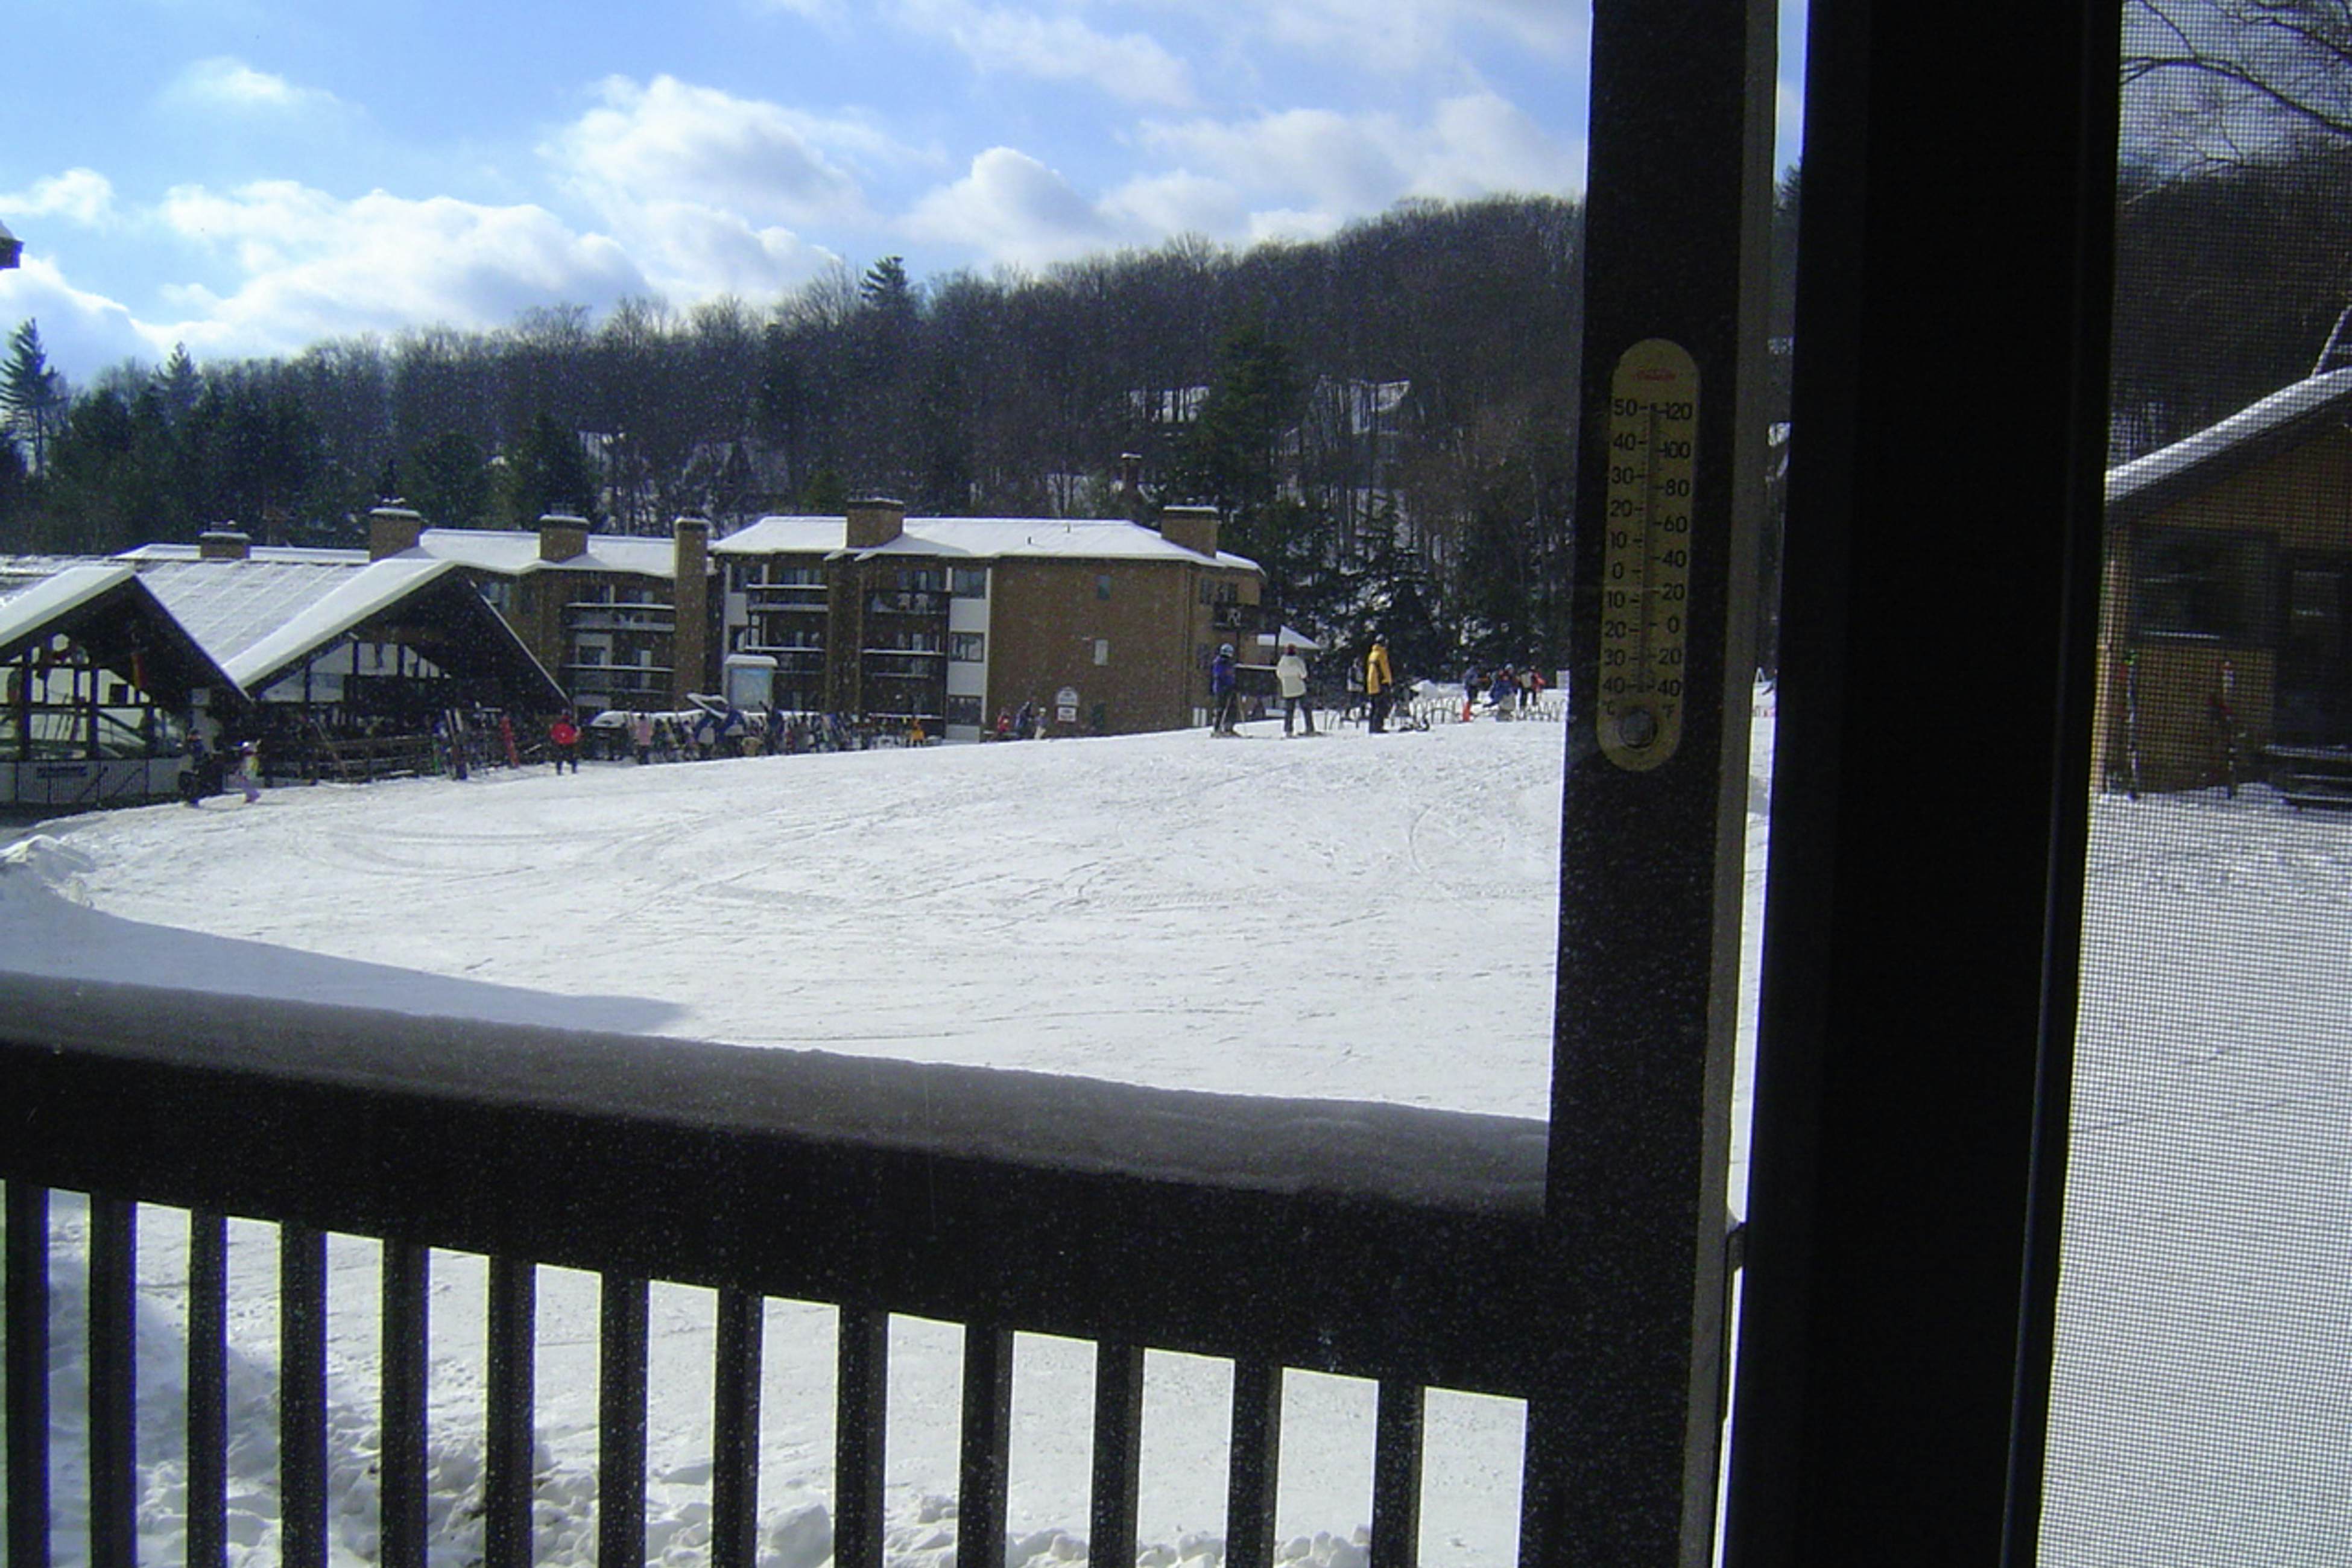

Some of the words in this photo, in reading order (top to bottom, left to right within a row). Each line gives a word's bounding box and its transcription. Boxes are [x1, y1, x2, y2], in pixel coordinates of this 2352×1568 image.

[1613, 399, 1637, 416] 50
[1666, 402, 1692, 420] 120
[1613, 433, 1636, 450] 40
[1664, 441, 1690, 458] 100
[1611, 467, 1634, 484] 30
[1665, 479, 1689, 496] 80
[1610, 499, 1633, 517] 20
[1664, 515, 1687, 533] 60
[1610, 531, 1627, 549] 10
[1663, 550, 1687, 568] 40
[1613, 562, 1624, 580] 0
[1607, 590, 1625, 609] 10
[1663, 583, 1686, 601] 20
[1605, 621, 1626, 639] 20
[1668, 616, 1680, 634] 0
[1604, 649, 1625, 666] 30
[1658, 648, 1681, 665] 20
[1602, 677, 1625, 694] 40
[1657, 680, 1681, 697] 40
